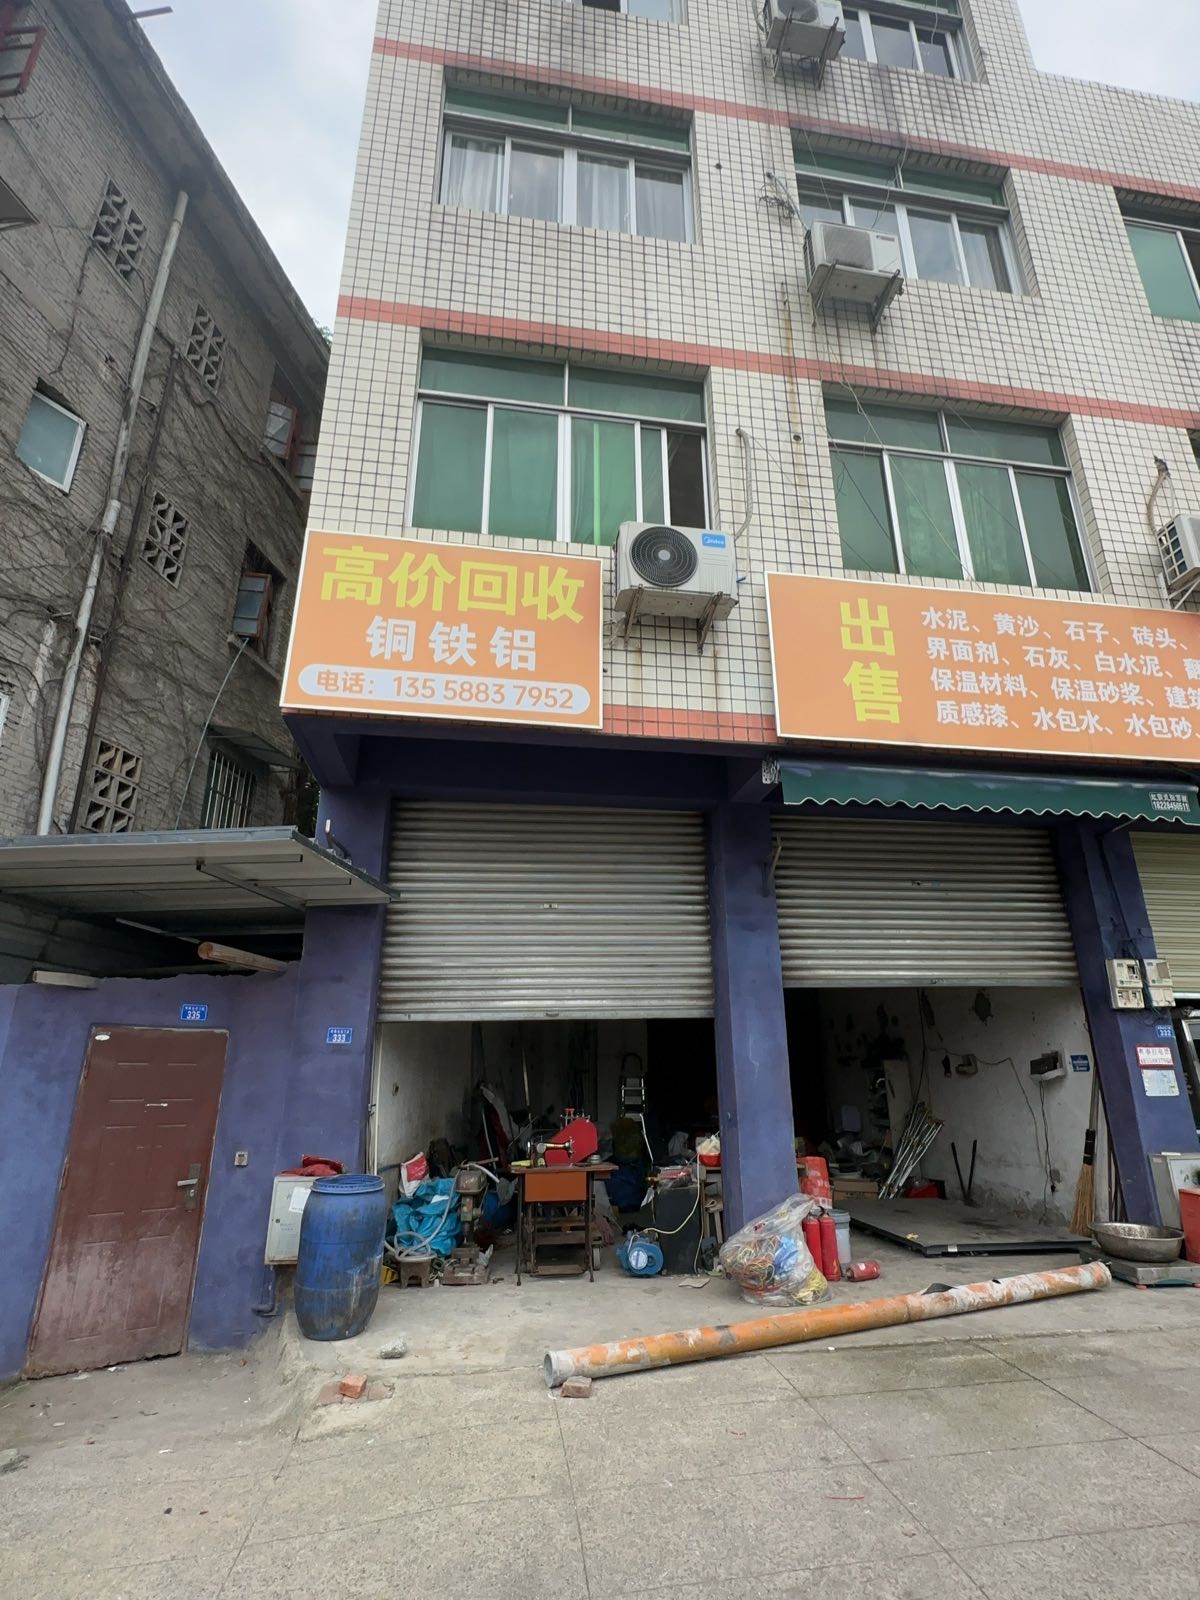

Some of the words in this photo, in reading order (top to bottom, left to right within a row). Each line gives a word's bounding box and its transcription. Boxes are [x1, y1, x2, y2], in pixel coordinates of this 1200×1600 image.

[320, 546, 585, 623] 高价回收
[839, 597, 903, 724] 出售
[186, 1010, 201, 1020] 335
[332, 1033, 346, 1042] 333
